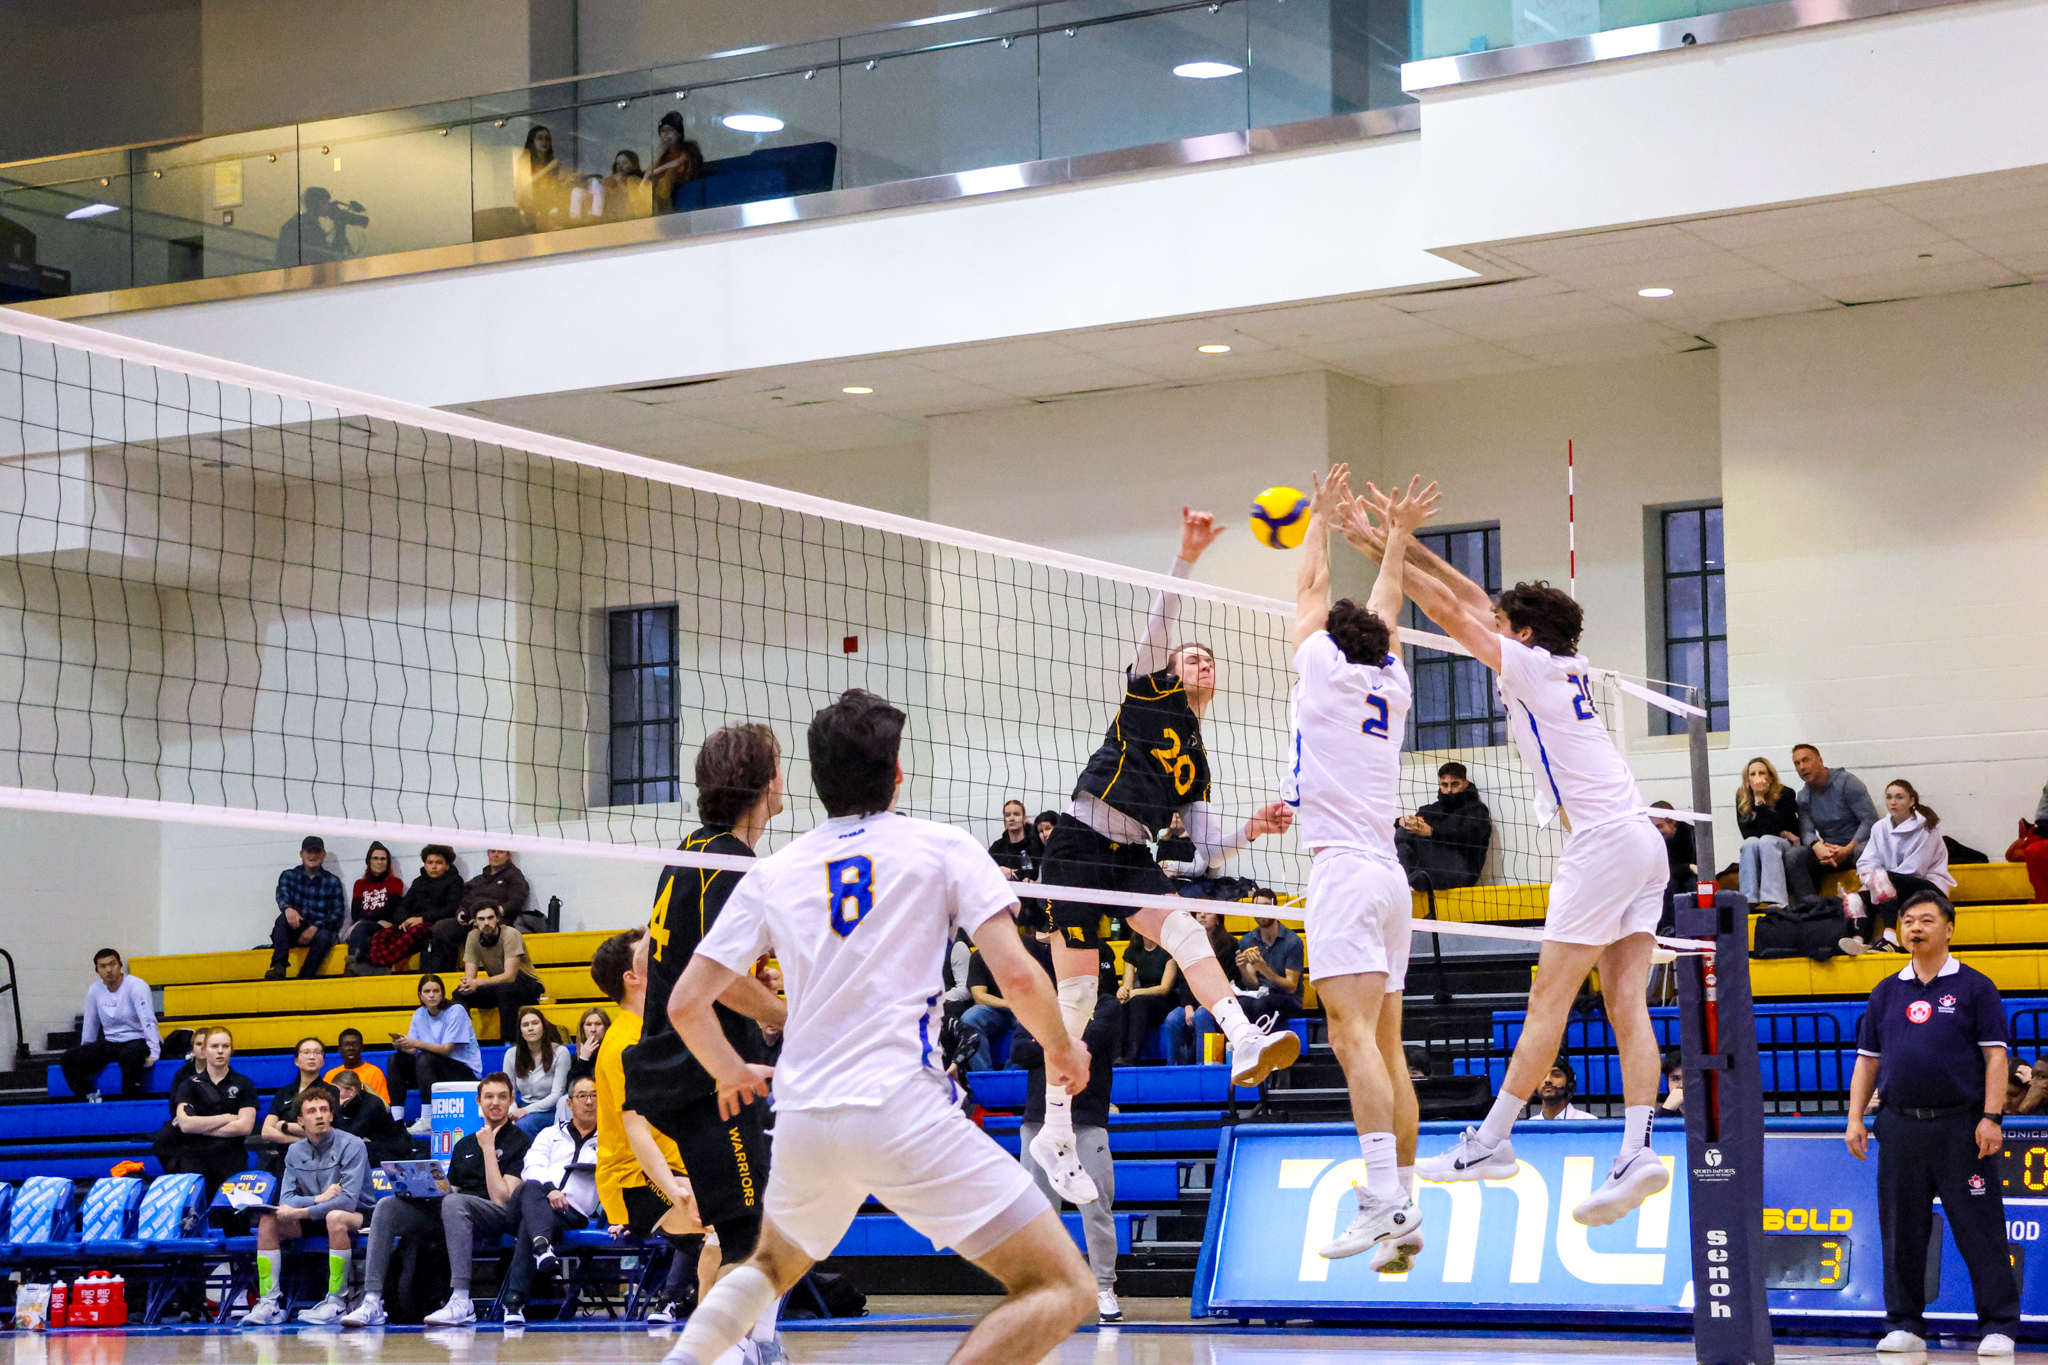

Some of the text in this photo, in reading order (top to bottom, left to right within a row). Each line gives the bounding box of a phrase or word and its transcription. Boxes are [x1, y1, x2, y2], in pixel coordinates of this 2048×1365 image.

[1361, 692, 1389, 741] 2
[1150, 728, 1196, 796] 20
[650, 875, 675, 962] 4
[825, 853, 875, 940] 8
[728, 1126, 755, 1207] WARRIORS
[1763, 1208, 1853, 1231] BOLD
[1706, 1230, 1731, 1318] senoh
[1819, 1241, 1842, 1284] 3
